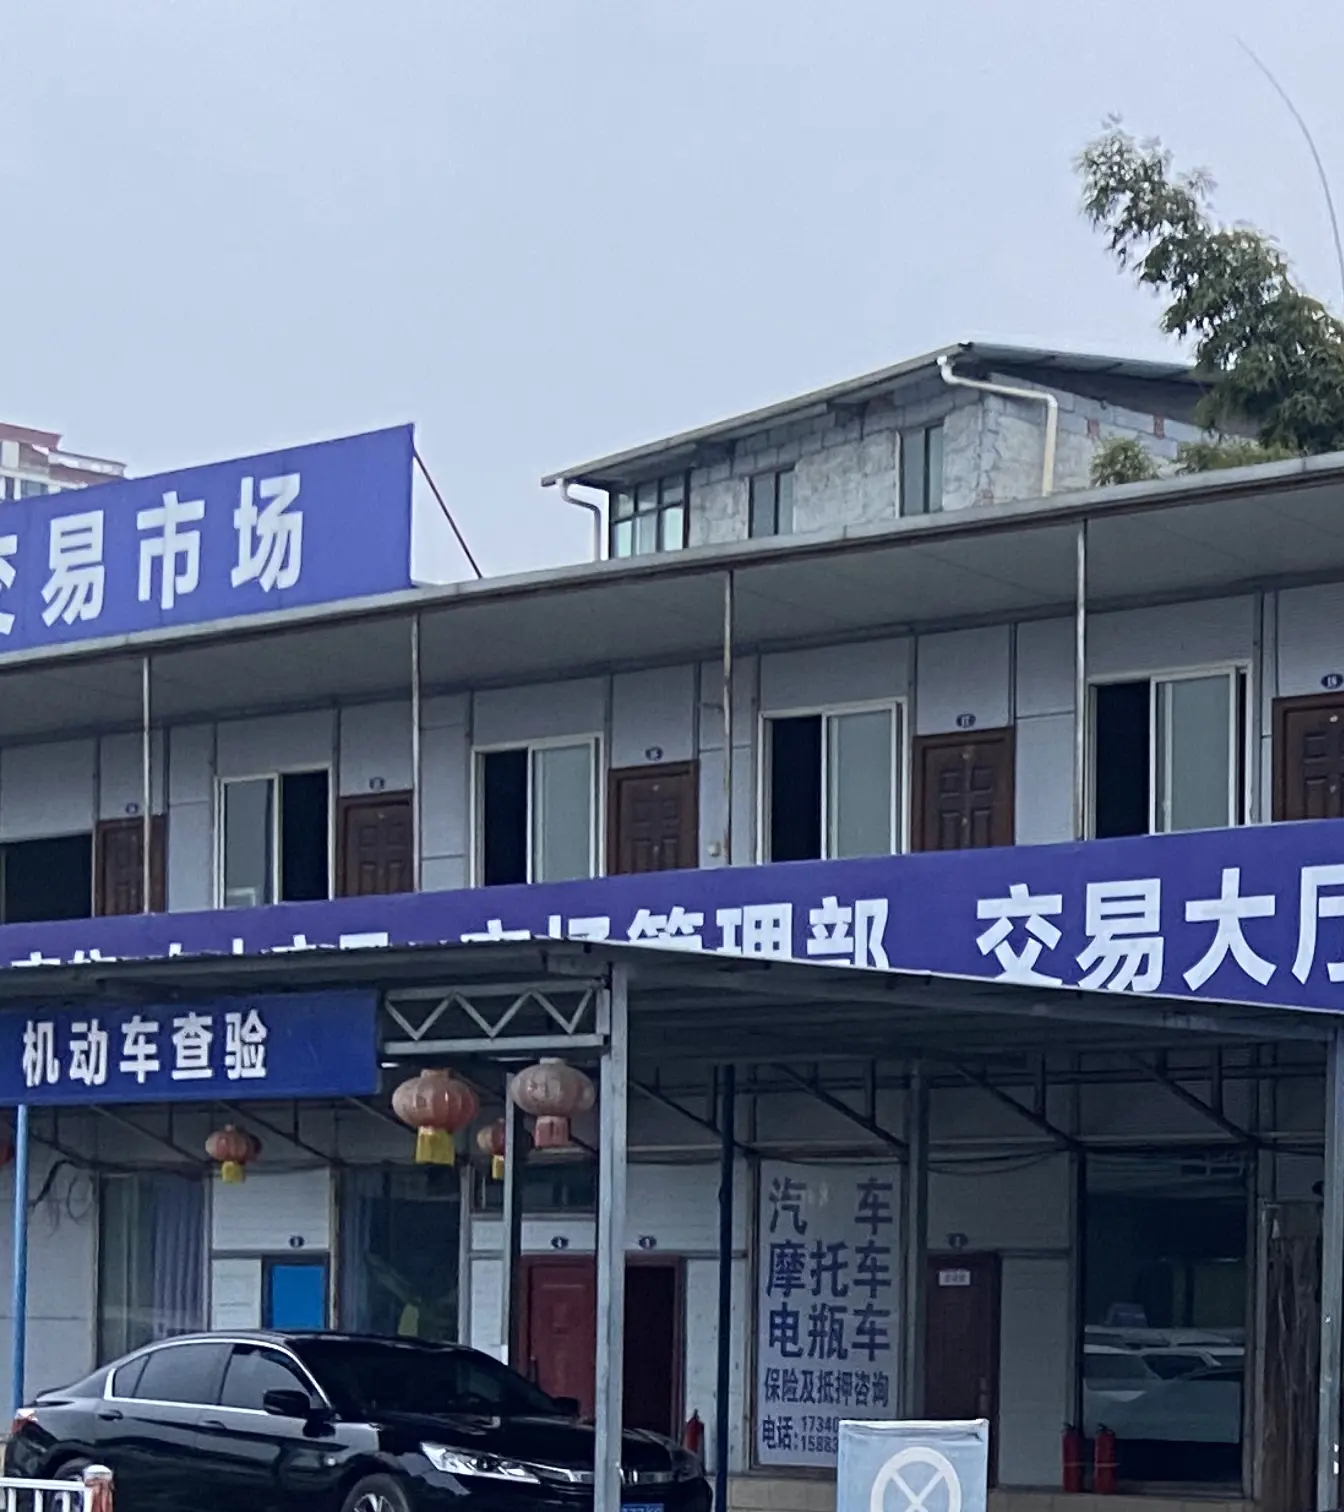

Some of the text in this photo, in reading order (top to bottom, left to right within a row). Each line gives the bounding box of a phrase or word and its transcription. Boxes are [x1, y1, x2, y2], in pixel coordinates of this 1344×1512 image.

[0, 472, 304, 636] 易市场
[21, 1008, 269, 1088] 机动车查验
[766, 1239, 892, 1299] 摩托车
[768, 1301, 891, 1362] 电瓶车
[763, 1366, 889, 1408] 保险及抵押咨询
